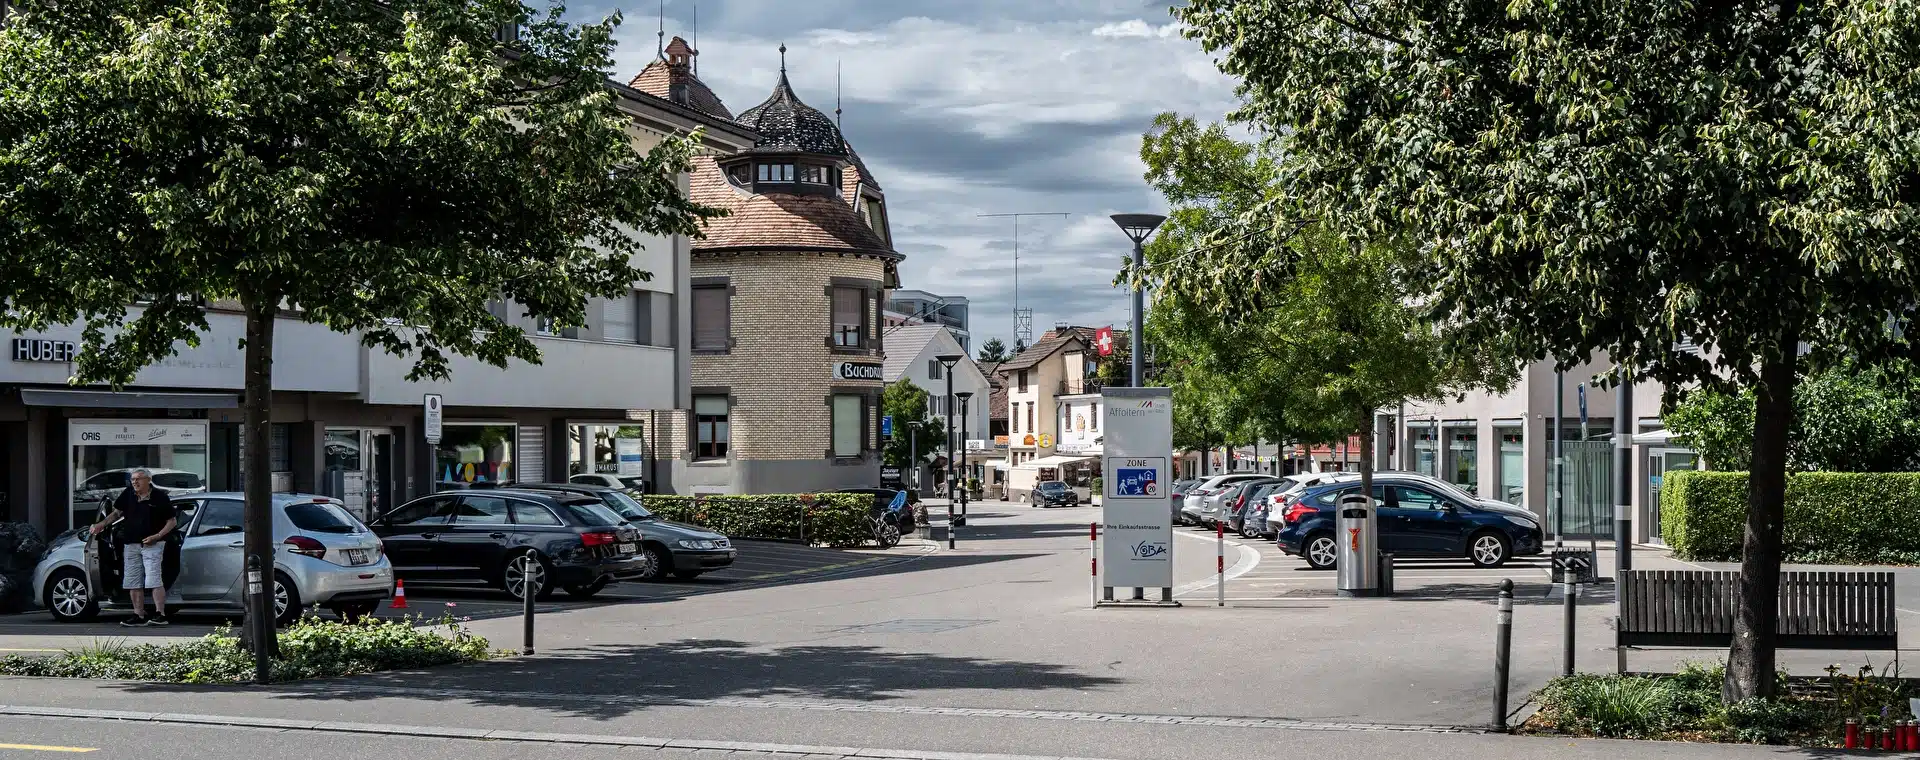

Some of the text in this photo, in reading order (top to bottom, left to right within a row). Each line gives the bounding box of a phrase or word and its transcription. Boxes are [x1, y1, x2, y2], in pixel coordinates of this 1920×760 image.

[18, 339, 75, 361] HUBER
[1109, 408, 1145, 416] Affoltern
[81, 432, 101, 441] ORIS
